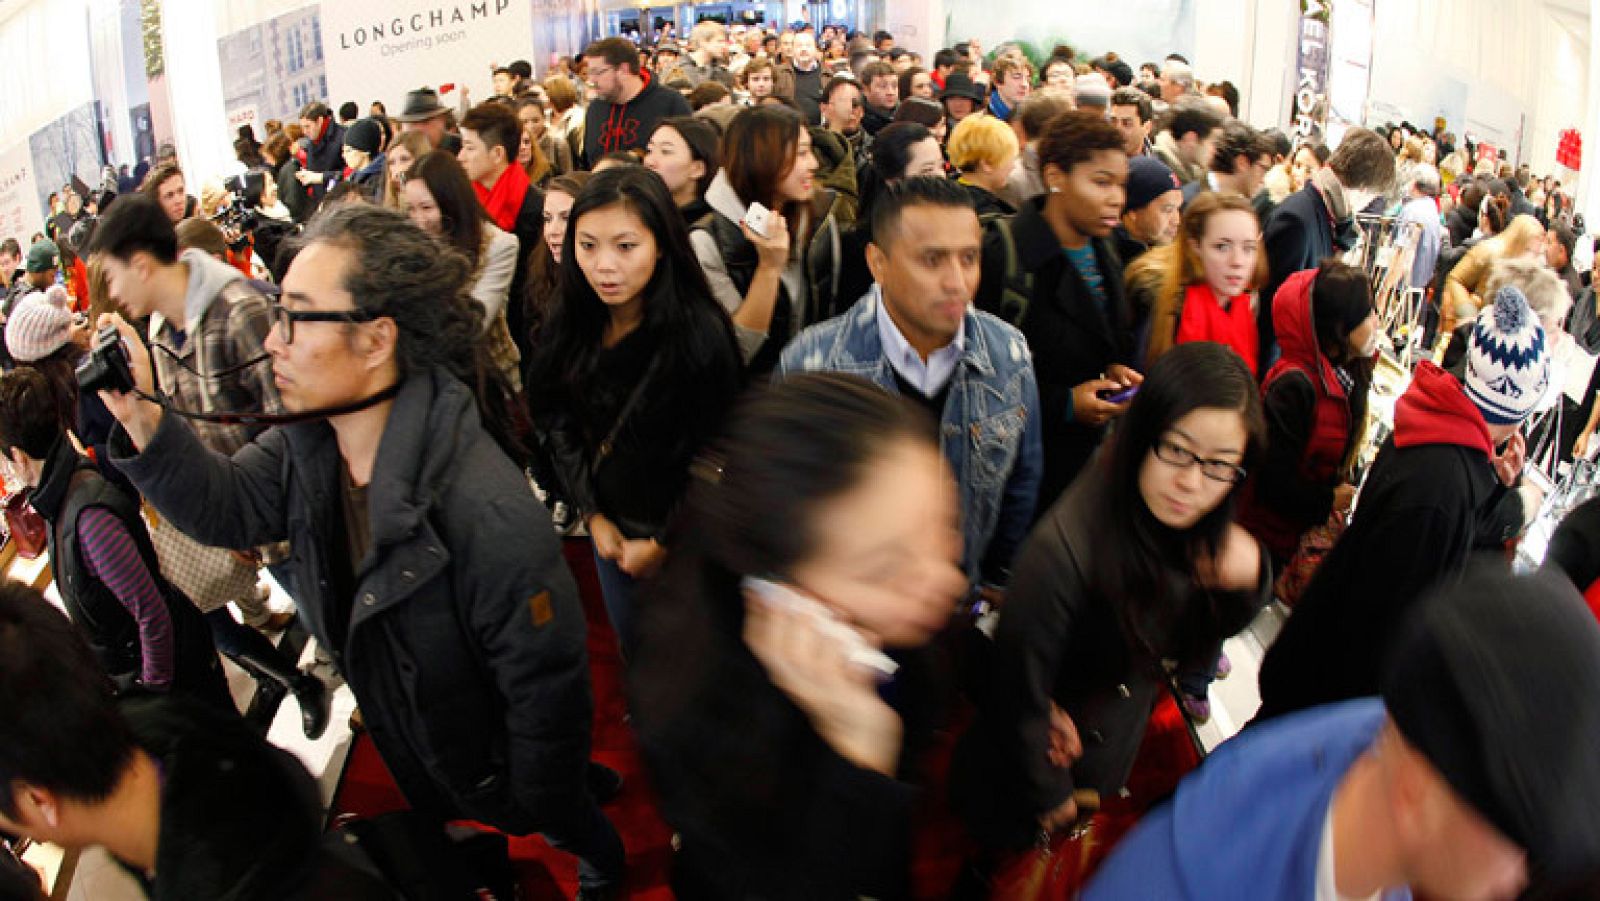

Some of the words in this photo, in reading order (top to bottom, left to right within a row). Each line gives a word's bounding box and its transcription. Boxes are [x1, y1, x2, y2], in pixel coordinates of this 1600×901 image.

[339, 0, 509, 49] LONGCHAMP
[381, 35, 432, 57] Opening
[436, 29, 467, 46] soon
